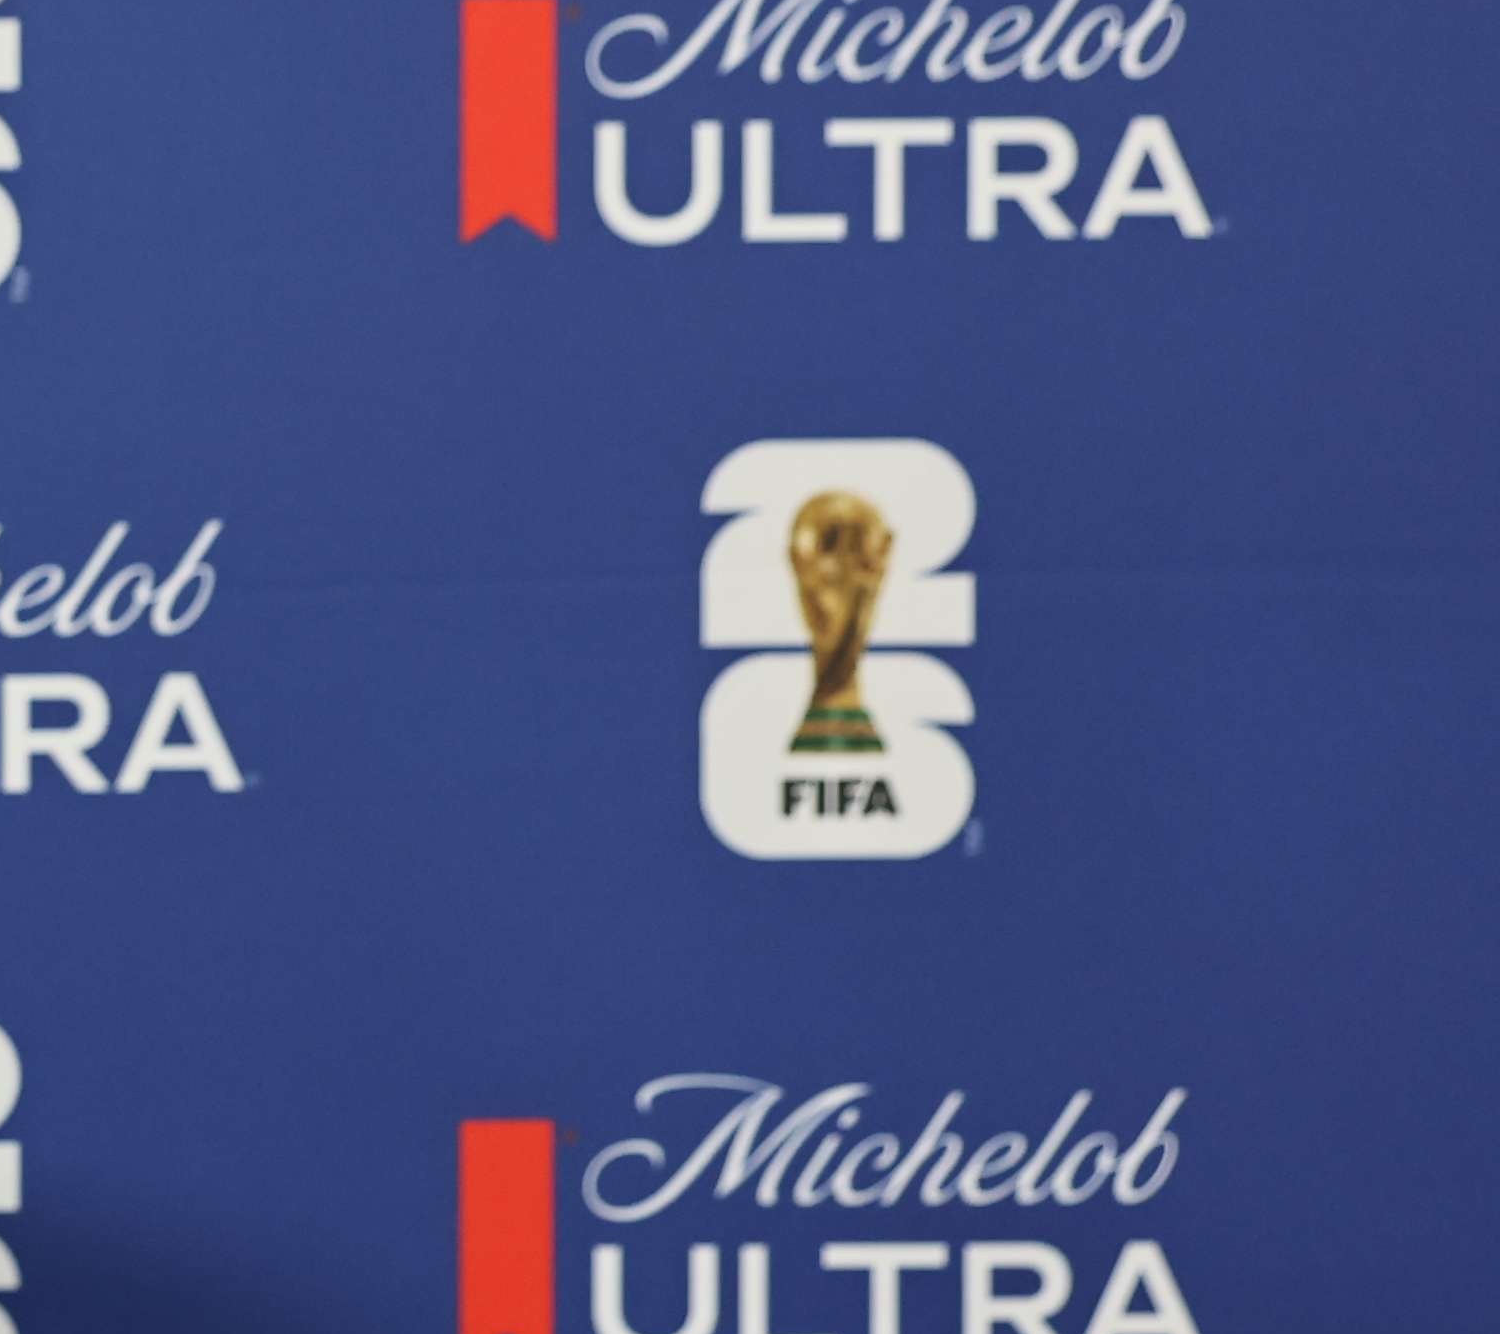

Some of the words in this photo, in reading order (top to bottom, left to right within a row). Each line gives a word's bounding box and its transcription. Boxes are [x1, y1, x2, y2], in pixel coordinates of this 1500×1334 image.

[593, 115, 1214, 247] ULTRA
[780, 776, 899, 819] FIFA
[582, 1073, 1187, 1223] Michelob
